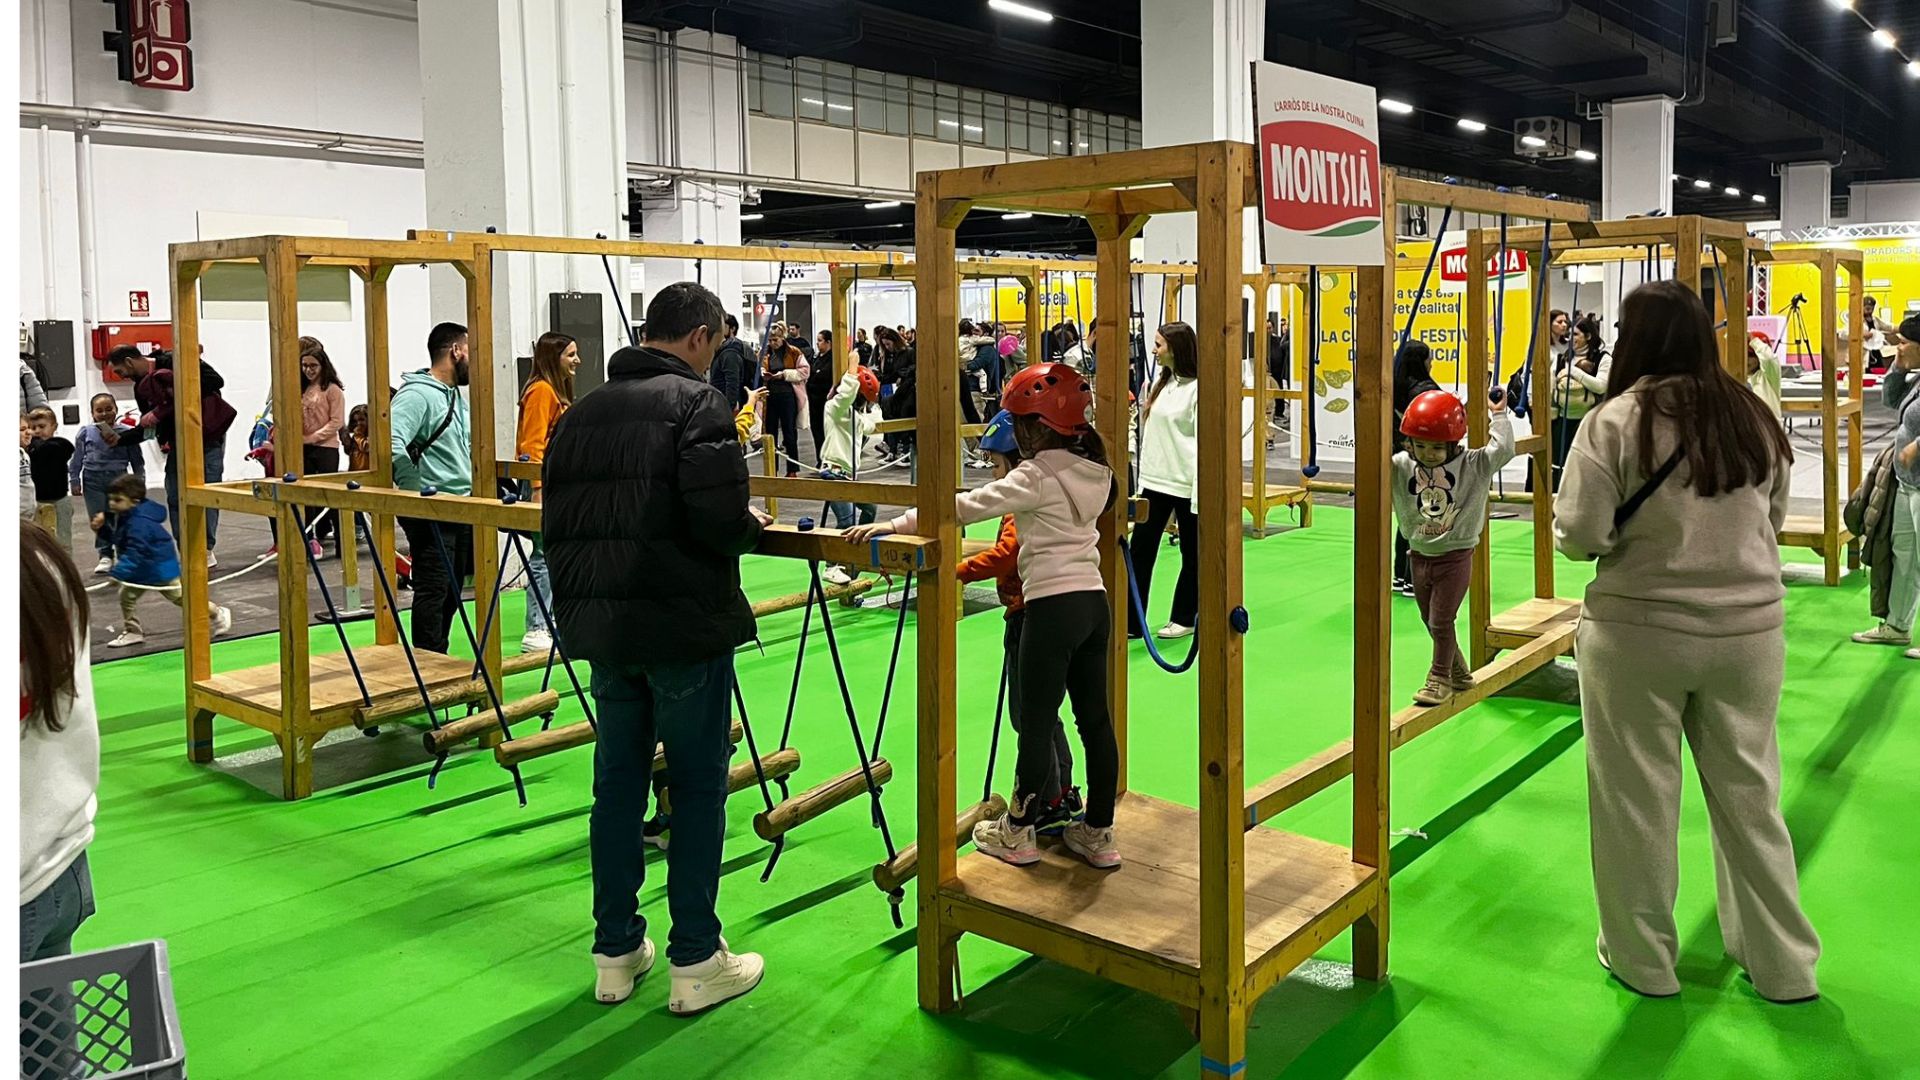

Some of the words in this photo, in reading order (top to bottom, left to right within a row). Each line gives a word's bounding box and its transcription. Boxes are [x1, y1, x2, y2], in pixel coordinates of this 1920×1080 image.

[1301, 101, 1311, 112] DE
[1311, 102, 1320, 112] LA
[1320, 103, 1345, 120] NOSTRA
[1346, 111, 1365, 128] CUINA
